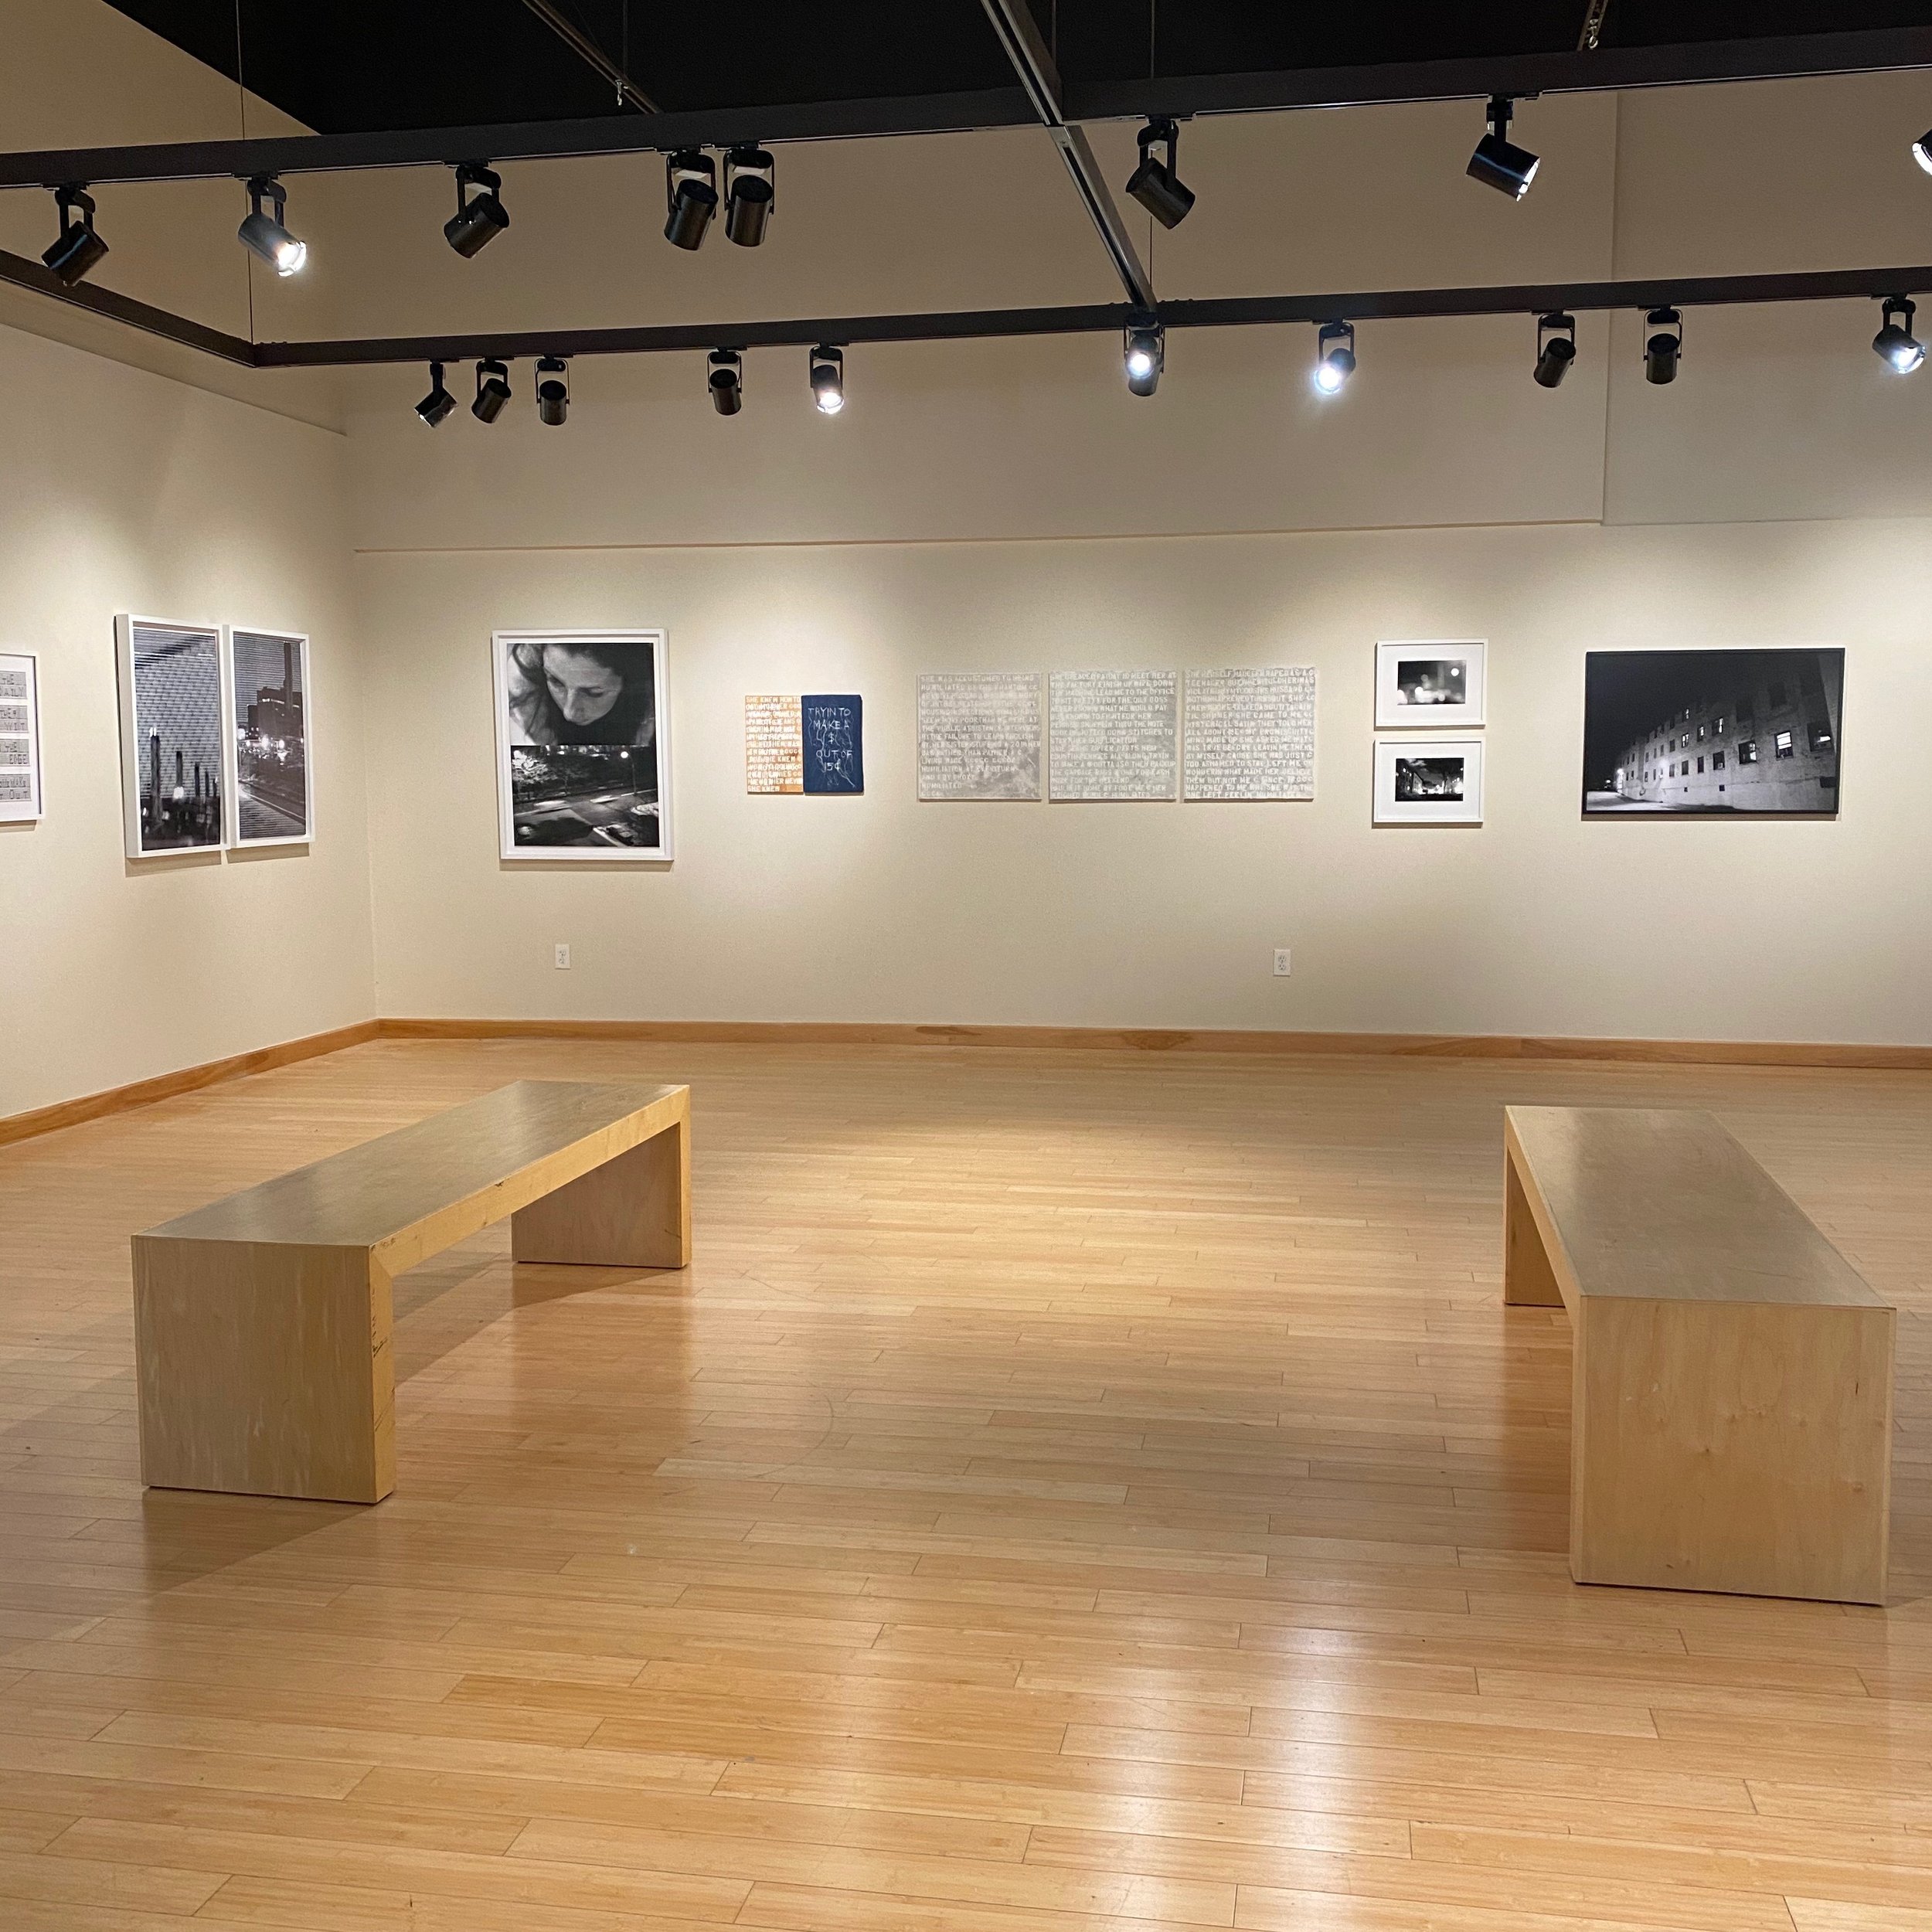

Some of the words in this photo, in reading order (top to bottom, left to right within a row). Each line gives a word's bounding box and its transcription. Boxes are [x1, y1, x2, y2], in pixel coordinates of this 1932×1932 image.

[808, 706, 836, 716] TRYIN
[838, 706, 852, 716] TO
[813, 719, 841, 730] MAKE
[844, 719, 849, 730] A
[828, 732, 835, 744] $
[816, 750, 838, 760] OUT
[841, 750, 852, 758] OF
